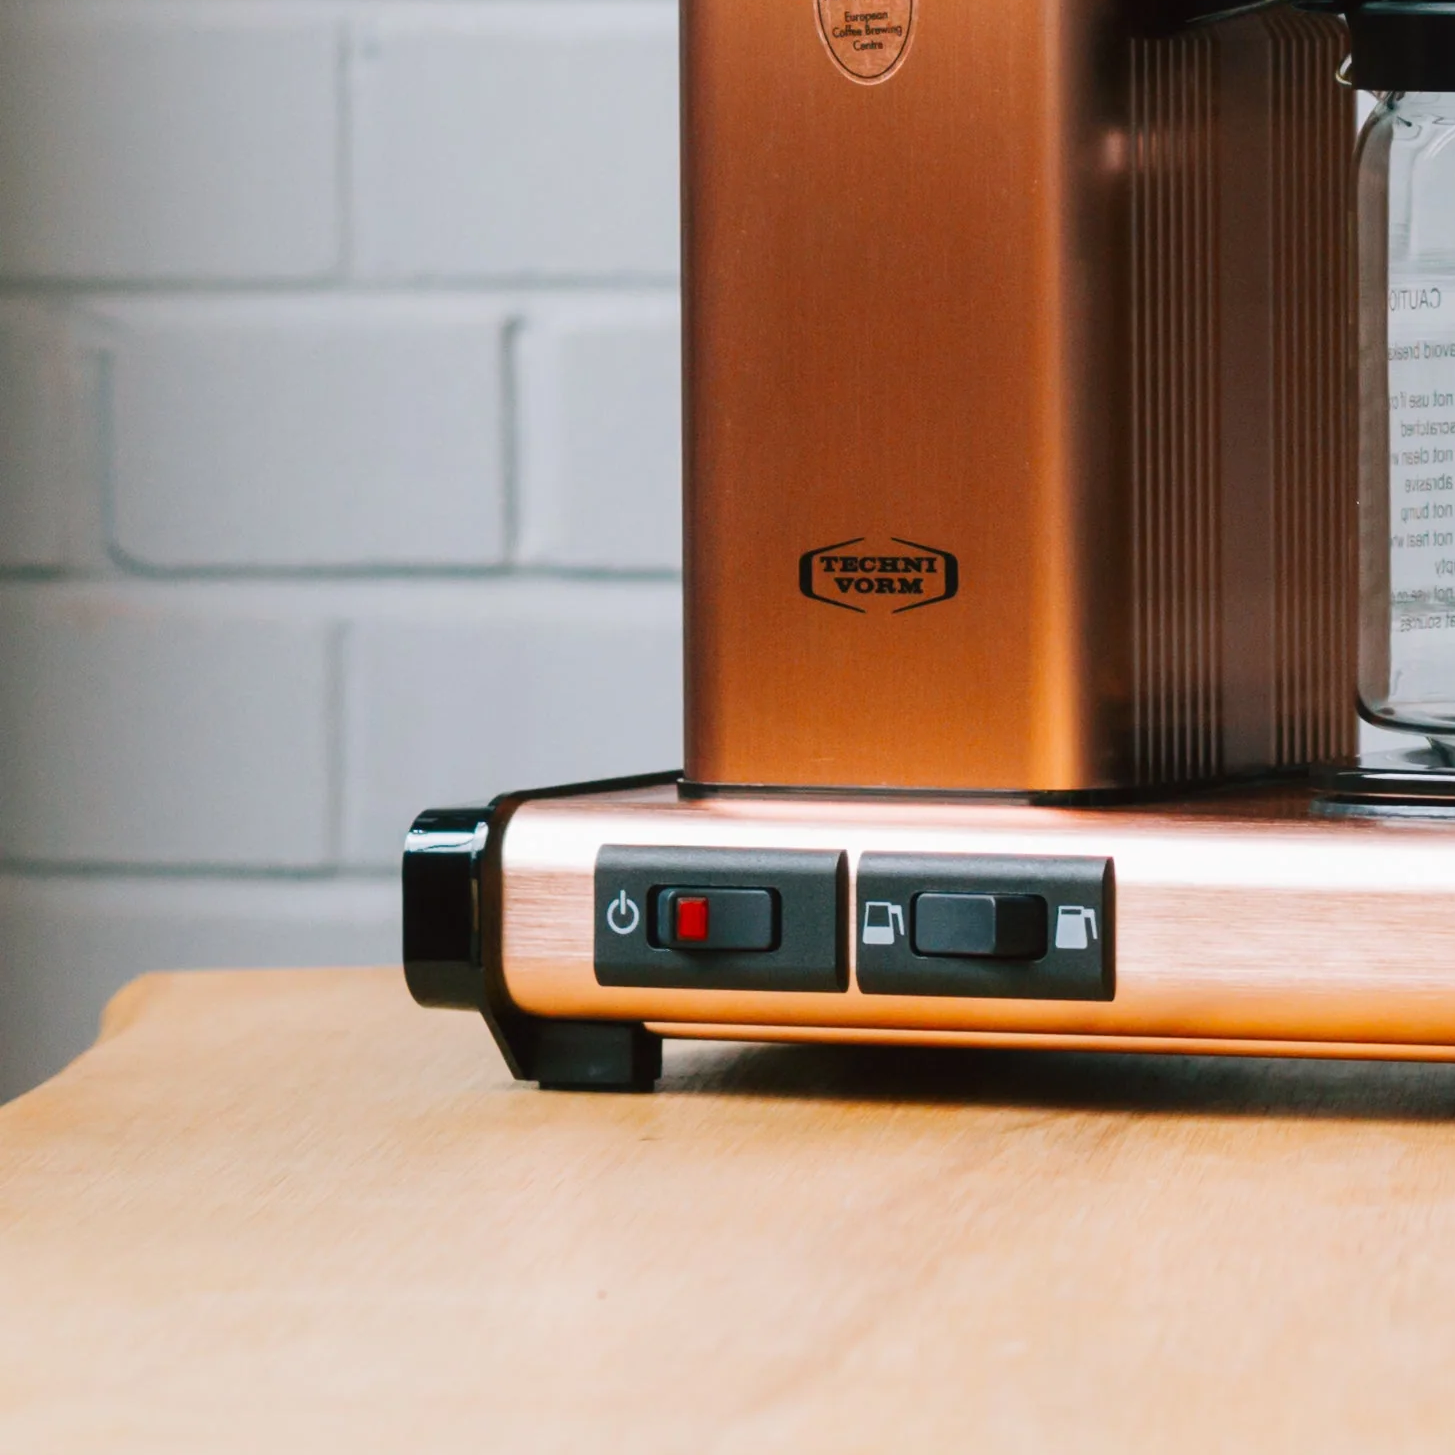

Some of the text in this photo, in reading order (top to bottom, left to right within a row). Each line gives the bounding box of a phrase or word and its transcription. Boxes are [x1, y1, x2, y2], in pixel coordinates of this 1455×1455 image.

[844, 11, 888, 24] European
[832, 24, 902, 39] Coffee Brewing
[853, 39, 883, 52] Centre
[820, 556, 938, 574] TECHNI
[834, 577, 924, 595] VORM
